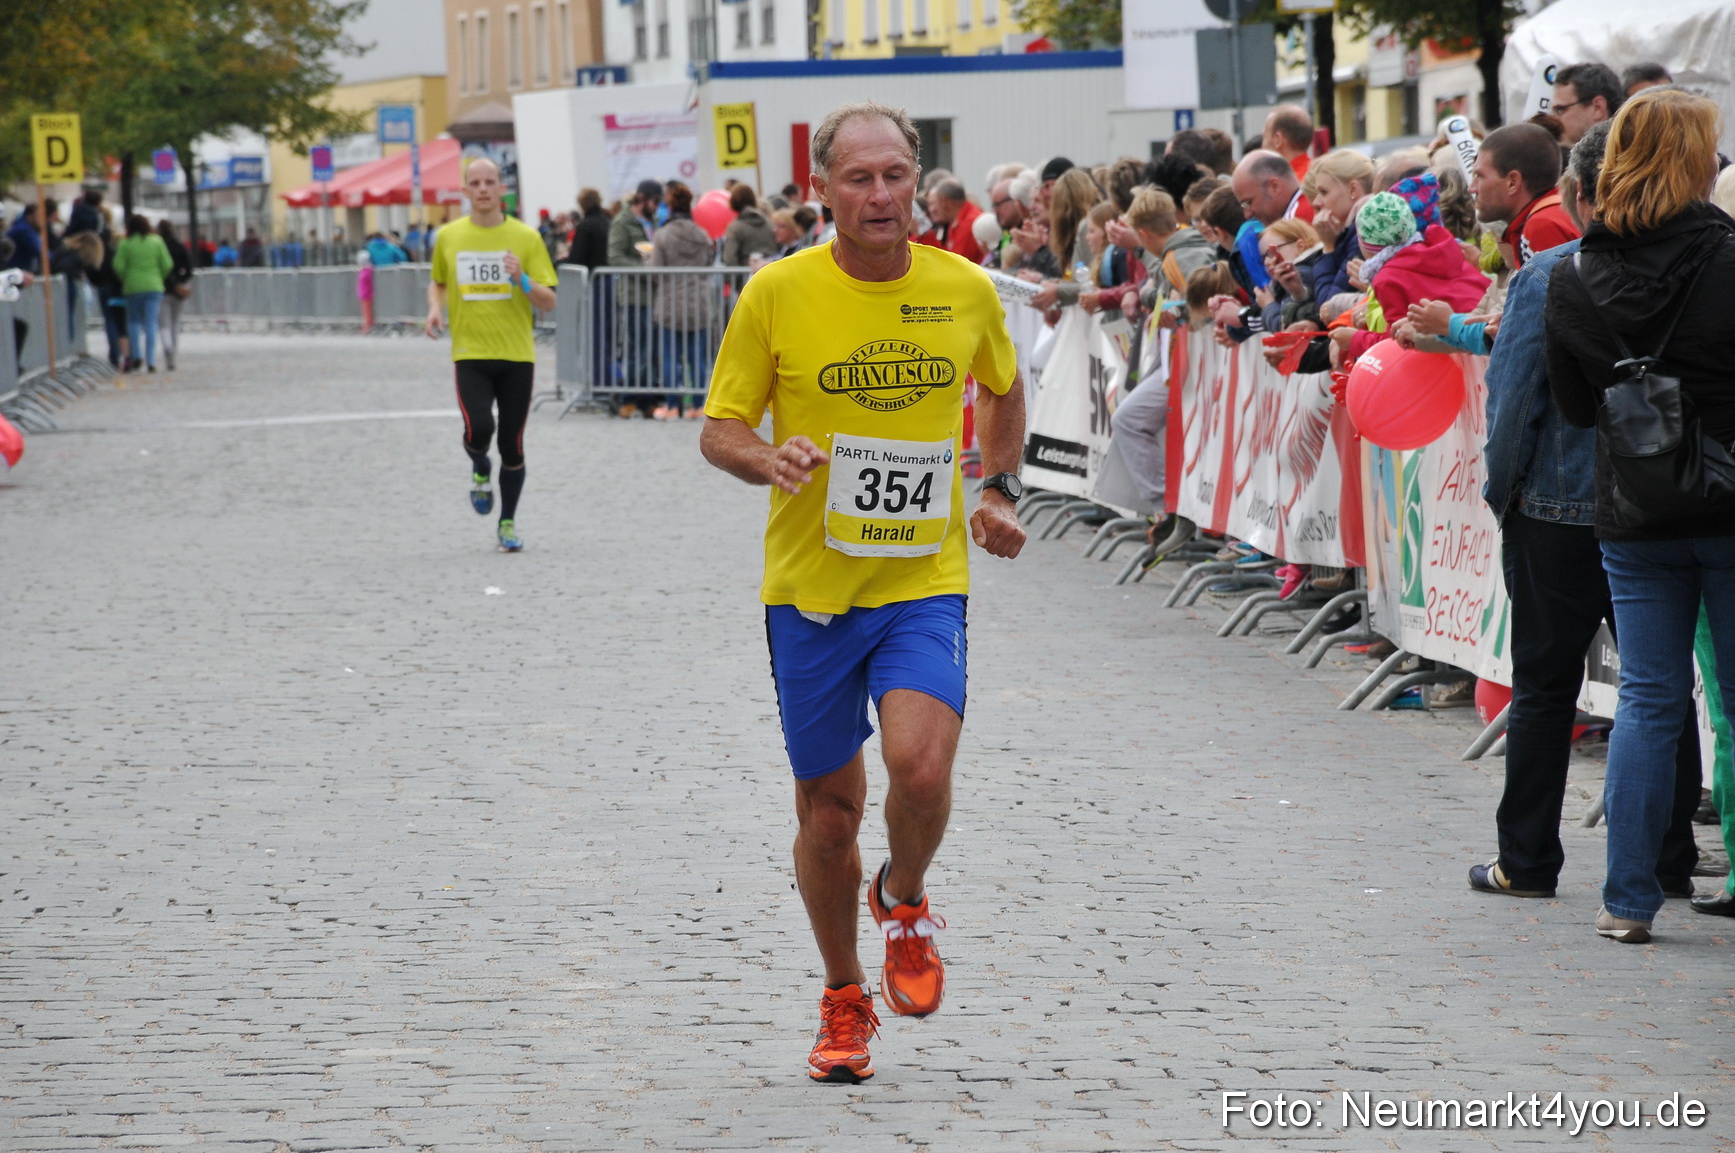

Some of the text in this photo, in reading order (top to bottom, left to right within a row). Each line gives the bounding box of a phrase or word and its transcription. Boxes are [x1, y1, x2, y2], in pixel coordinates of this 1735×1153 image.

[717, 105, 753, 119] Block
[38, 118, 73, 130] Block
[726, 124, 747, 154] D
[46, 135, 69, 167] D
[468, 264, 501, 282] 168
[852, 341, 925, 364] PIZZERIA
[836, 361, 942, 388] FRANCESCO
[853, 387, 928, 411] HERSBRUCK
[835, 446, 941, 466] PARTL Neumarkt
[855, 467, 934, 513] 354
[830, 502, 837, 511] C
[861, 523, 916, 541] Harald
